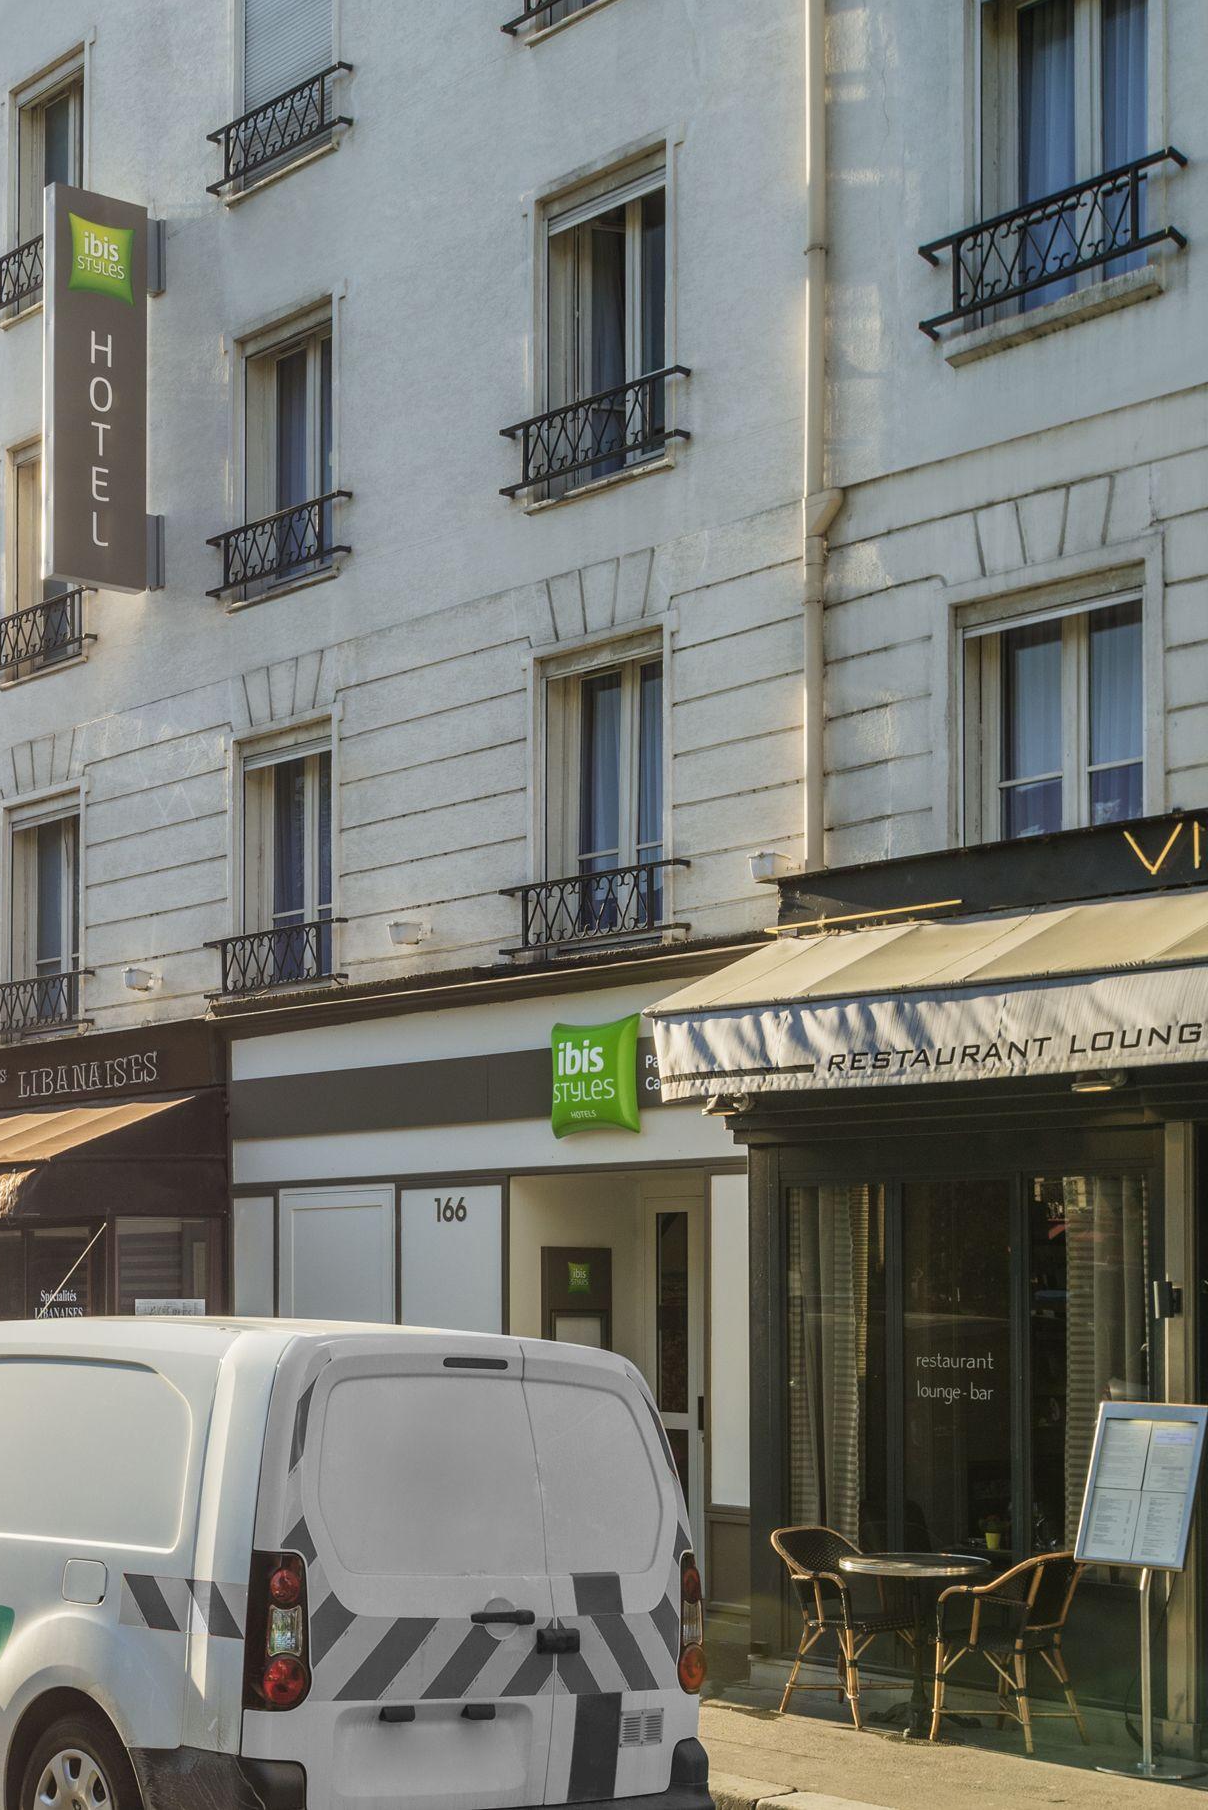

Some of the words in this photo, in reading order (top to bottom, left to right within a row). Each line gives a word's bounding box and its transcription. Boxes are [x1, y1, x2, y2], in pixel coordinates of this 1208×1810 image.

[84, 232, 119, 261] ibis
[89, 330, 112, 547] HOTEL
[558, 1039, 604, 1076] ibis
[827, 1036, 1052, 1072] RESTAURANT
[1068, 1022, 1203, 1055] LOUNG
[18, 1051, 158, 1098] LIBANAISES
[570, 1109, 598, 1119] HOTELS
[434, 1196, 467, 1222] 166
[572, 1268, 587, 1279] ibis
[34, 1307, 84, 1318] LIBANAISES
[916, 1352, 994, 1369] restaurant
